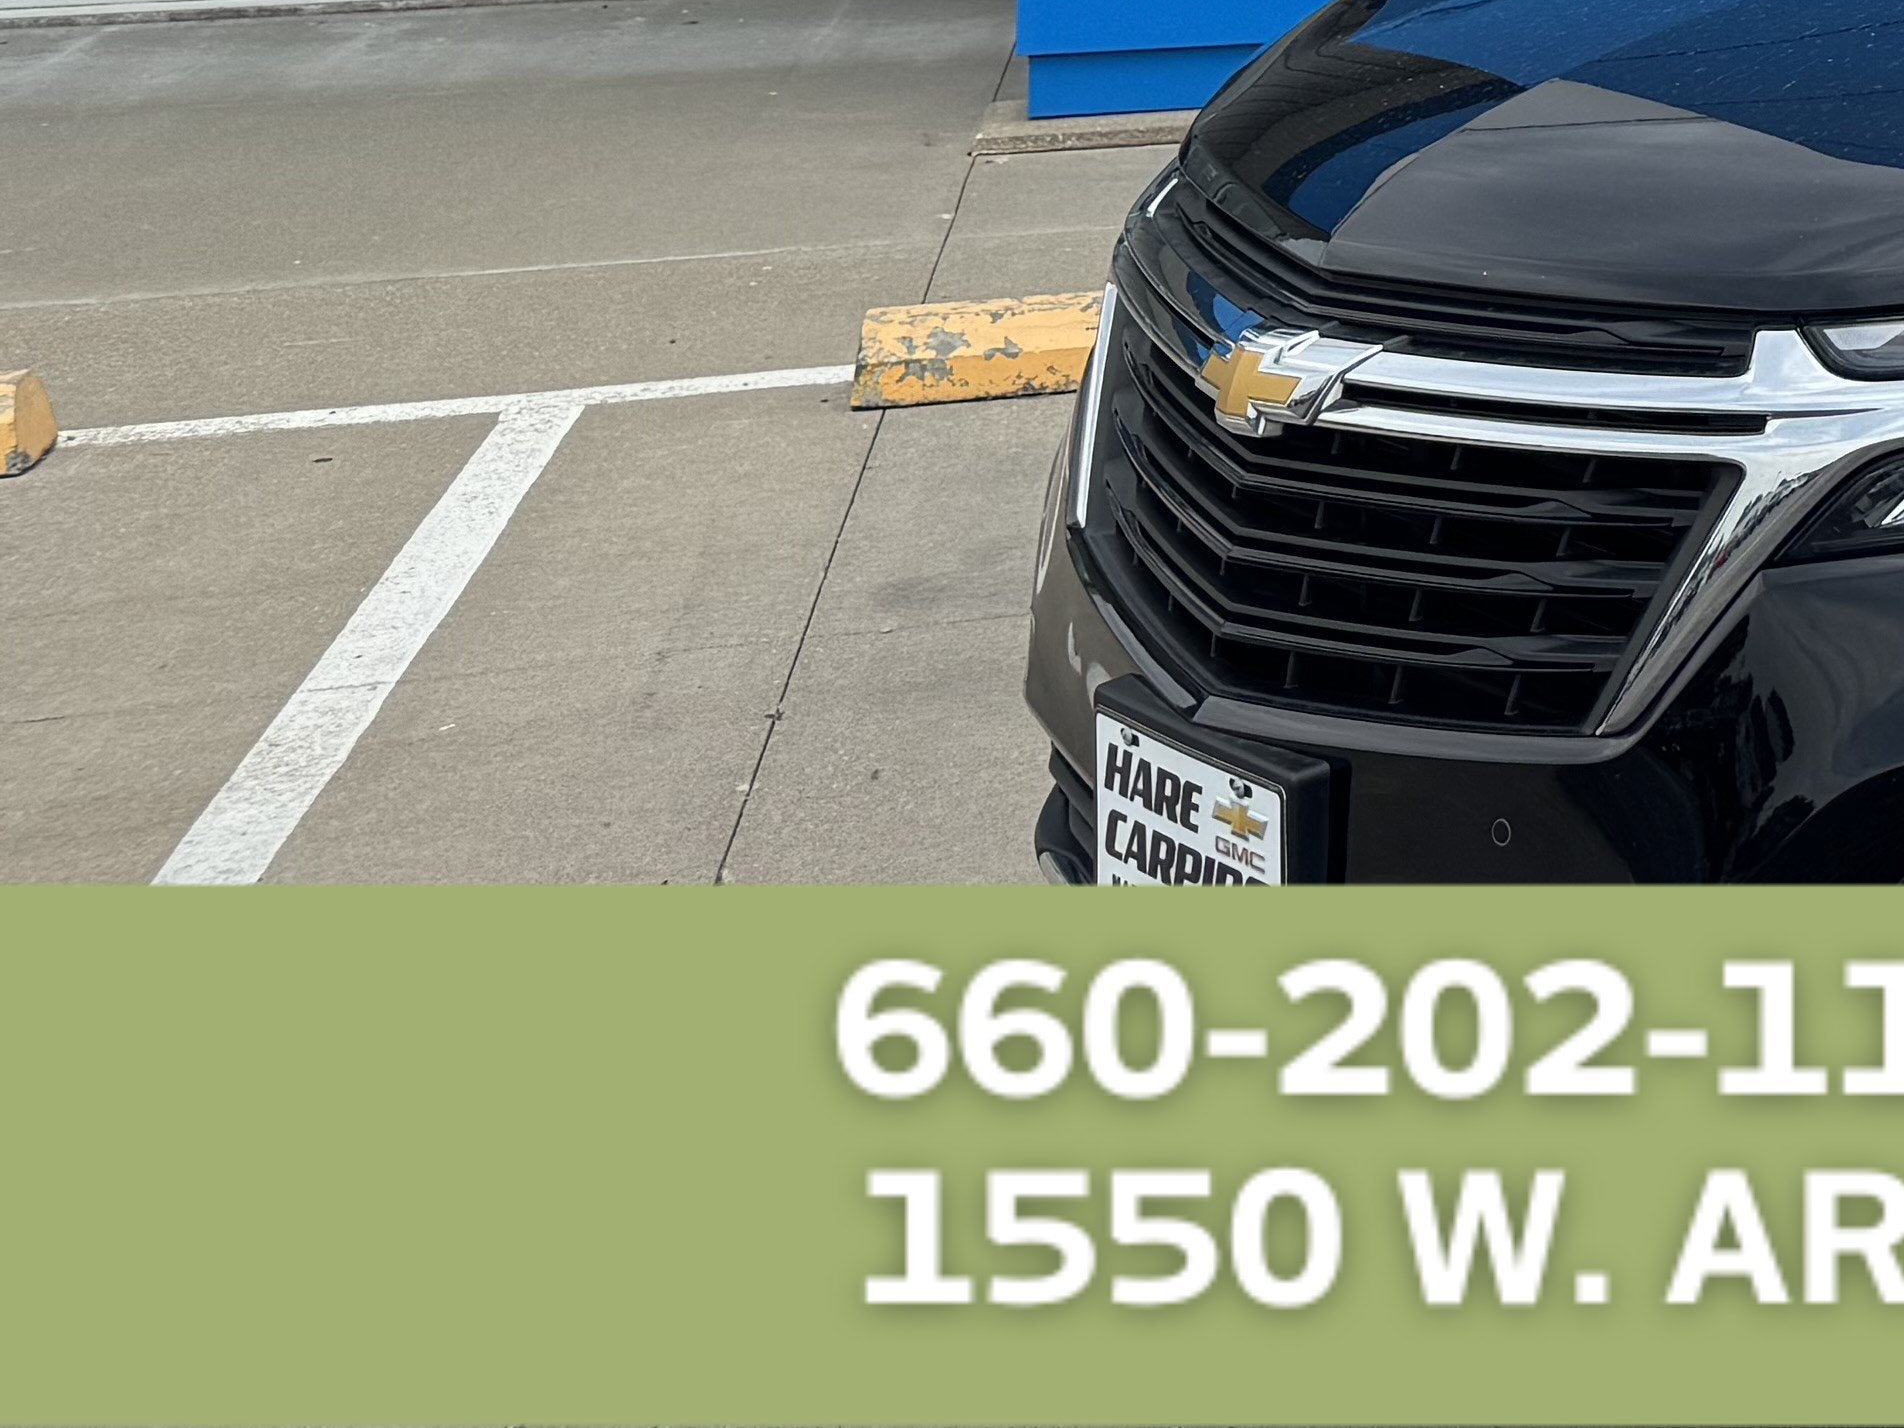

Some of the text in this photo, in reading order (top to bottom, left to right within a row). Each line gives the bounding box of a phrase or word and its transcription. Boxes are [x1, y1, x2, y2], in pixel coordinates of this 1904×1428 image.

[1104, 742, 1203, 834] HARE
[1104, 808, 1272, 887] CARPI
[1215, 834, 1266, 875] GMC
